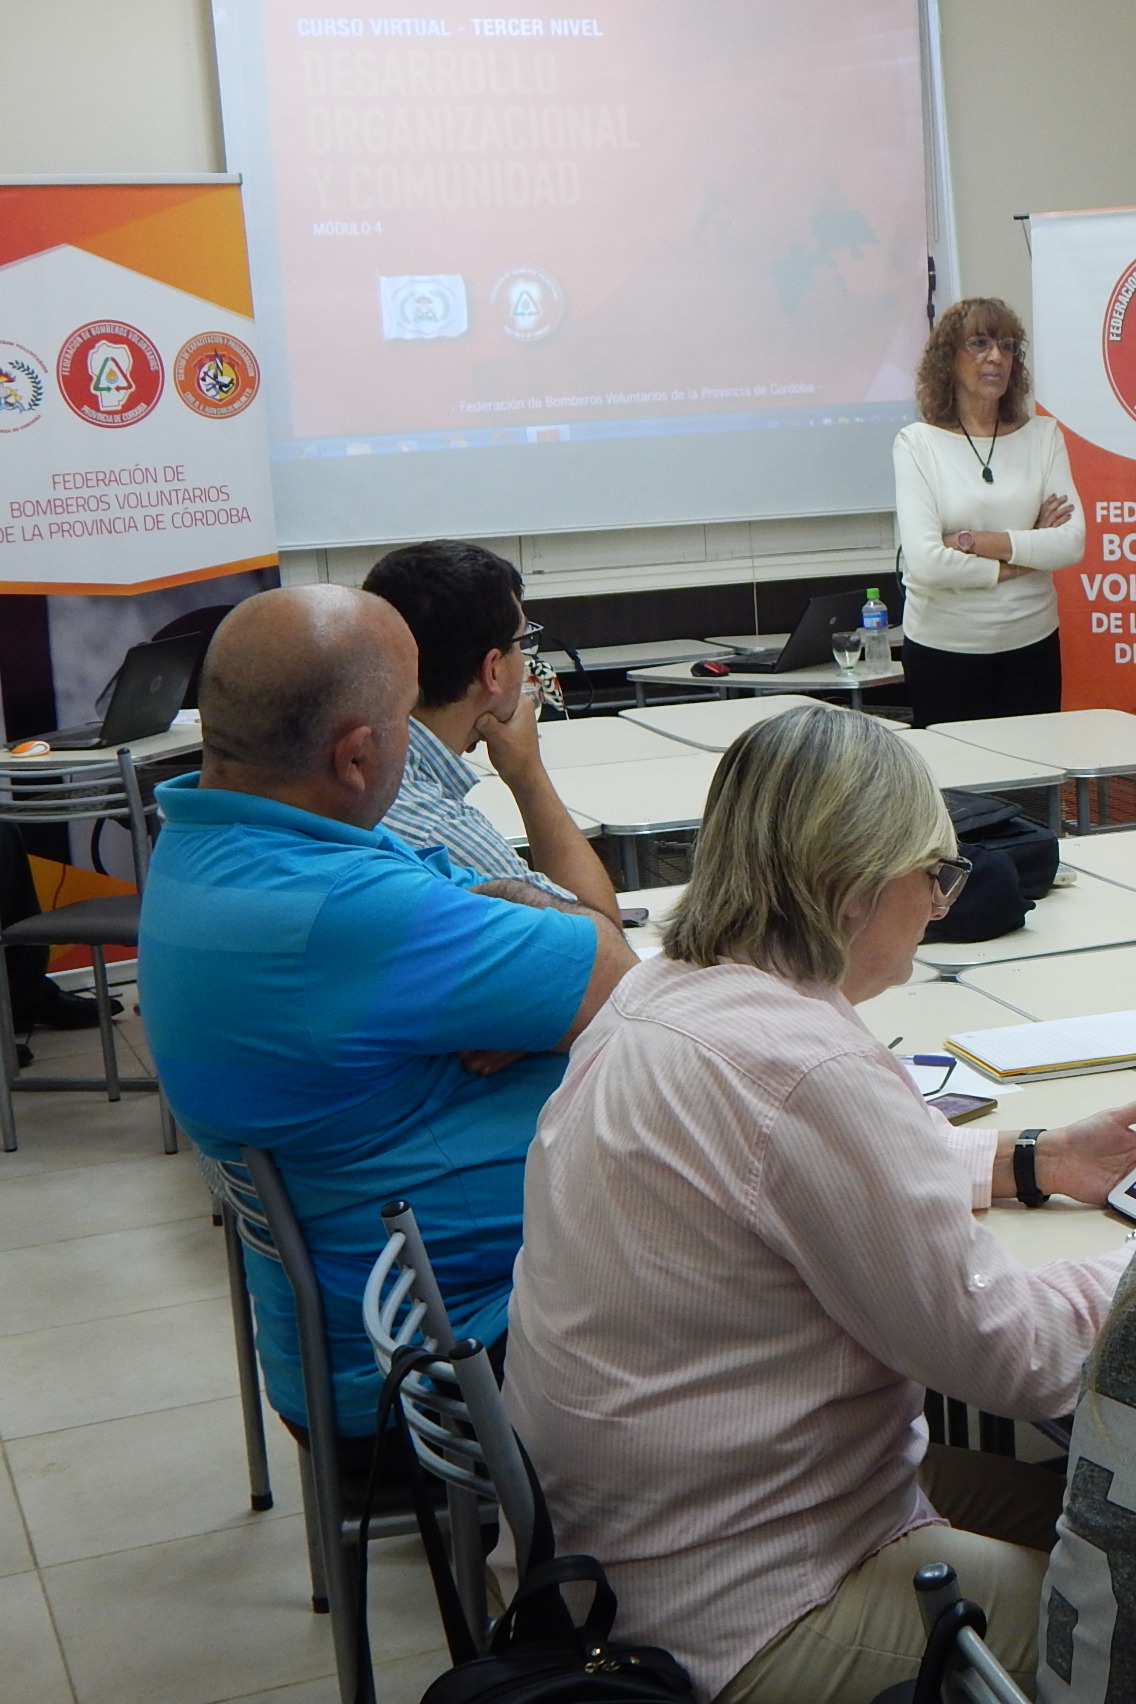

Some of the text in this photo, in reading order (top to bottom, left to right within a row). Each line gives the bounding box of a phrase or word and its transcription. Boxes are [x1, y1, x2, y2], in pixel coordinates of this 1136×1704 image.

[297, 18, 363, 37] CURSO
[370, 18, 451, 37] VIRTUAL
[471, 18, 544, 37] TERCER
[550, 19, 604, 37] NIVEL
[302, 49, 559, 98] DESARROLLO
[307, 104, 641, 155] ORGANIZACIONAL
[309, 159, 582, 212] Y COMUNIDAD
[374, 222, 382, 233] 4
[528, 398, 542, 409] de
[545, 394, 602, 408] Bomberos
[605, 390, 668, 404] Voluntarios
[671, 389, 685, 400] de
[700, 387, 751, 399] Provincia
[753, 385, 767, 396] de
[52, 464, 186, 491] FEDERACIÓN DE
[10, 485, 230, 519] BOMBEROS VOLUNTARIOS
[21, 524, 44, 542] LA
[48, 516, 139, 540] PROVINCIA
[143, 514, 167, 532] DE
[171, 506, 252, 530] CÓRDOBA
[1091, 612, 1123, 633] DE
